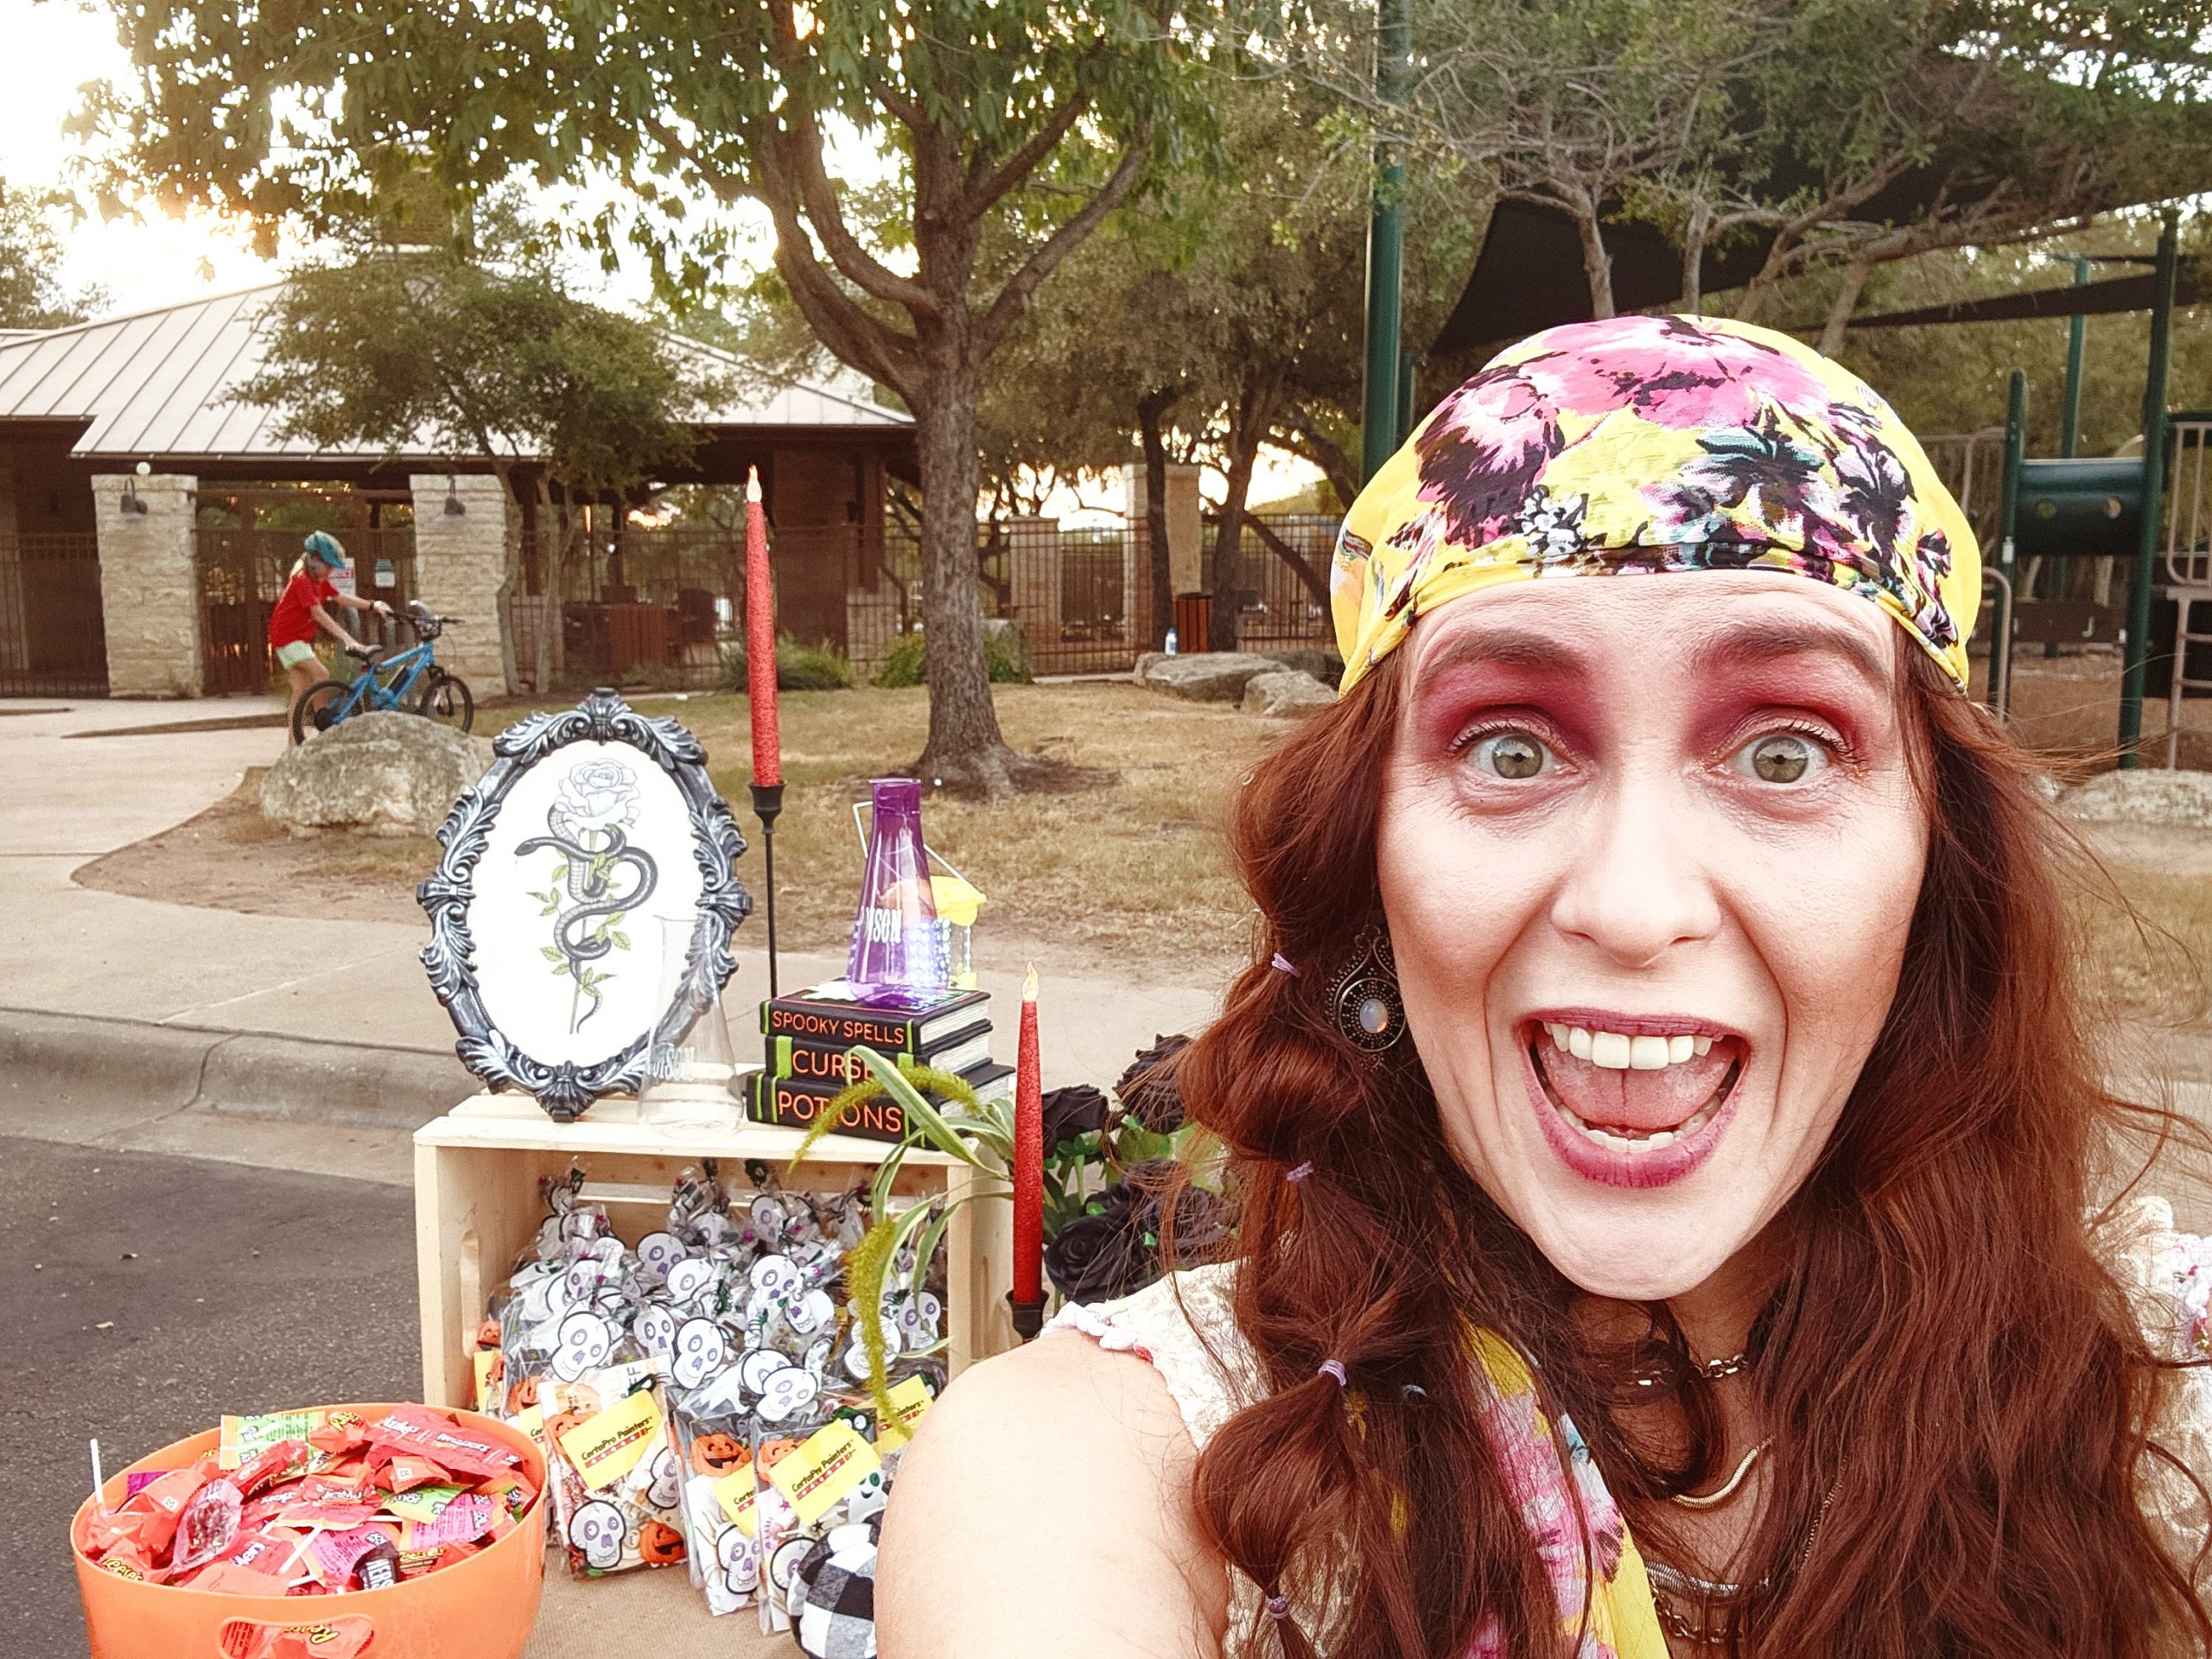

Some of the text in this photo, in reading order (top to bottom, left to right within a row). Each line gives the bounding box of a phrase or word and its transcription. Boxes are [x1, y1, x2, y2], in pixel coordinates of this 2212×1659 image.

[772, 1010, 906, 1045] SPOOKY SPELLS
[791, 1049, 895, 1081] CURSE
[777, 1090, 902, 1133] POTONS
[581, 1419, 651, 1460] CertaPro Painters
[791, 1441, 852, 1492] CertaPro Painters
